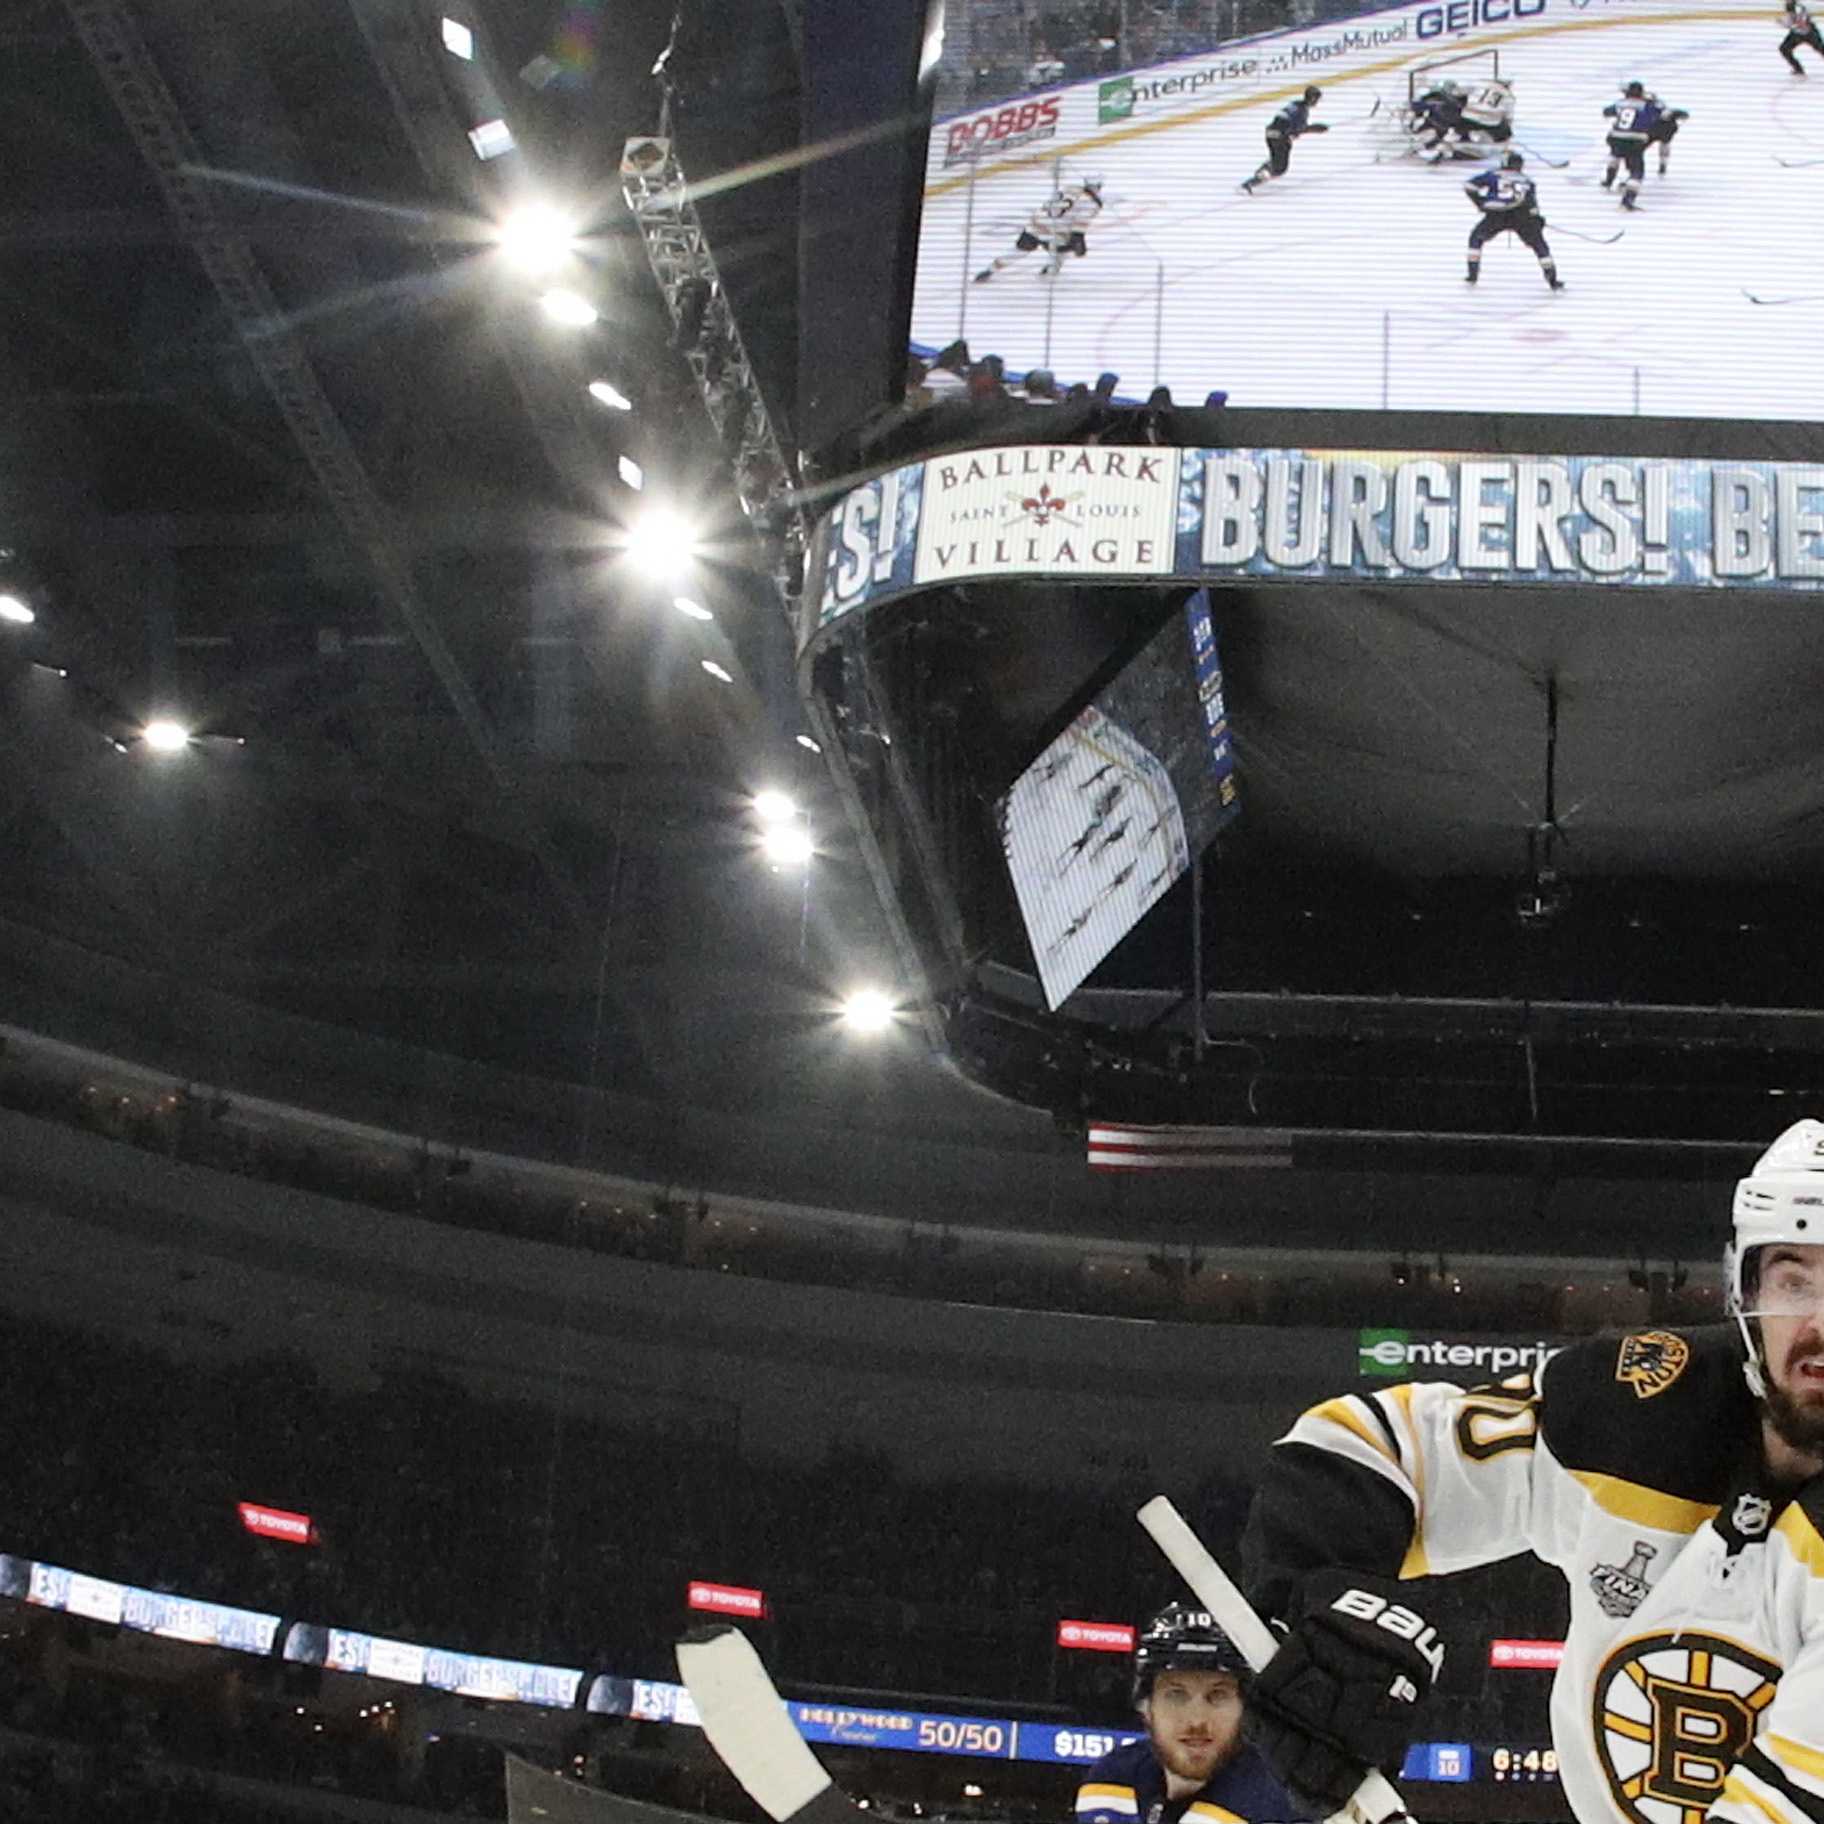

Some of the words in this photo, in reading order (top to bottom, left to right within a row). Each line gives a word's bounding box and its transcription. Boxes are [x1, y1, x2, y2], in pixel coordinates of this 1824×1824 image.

[1416, 0, 1546, 40] GEICO
[1291, 20, 1408, 67] MassMutual
[948, 96, 1062, 152] DOBBS
[938, 450, 1163, 491] BALLPARK
[949, 504, 1007, 524] SAINT
[1075, 502, 1142, 521] LOUIS
[1202, 457, 1670, 577] BURGERS!
[934, 536, 1155, 570] VILLAGE
[1370, 1338, 1564, 1382] enterpri
[1186, 1612, 1212, 1628] 10
[917, 1719, 1002, 1752] 50/50
[1492, 1748, 1558, 1773] 6:48
